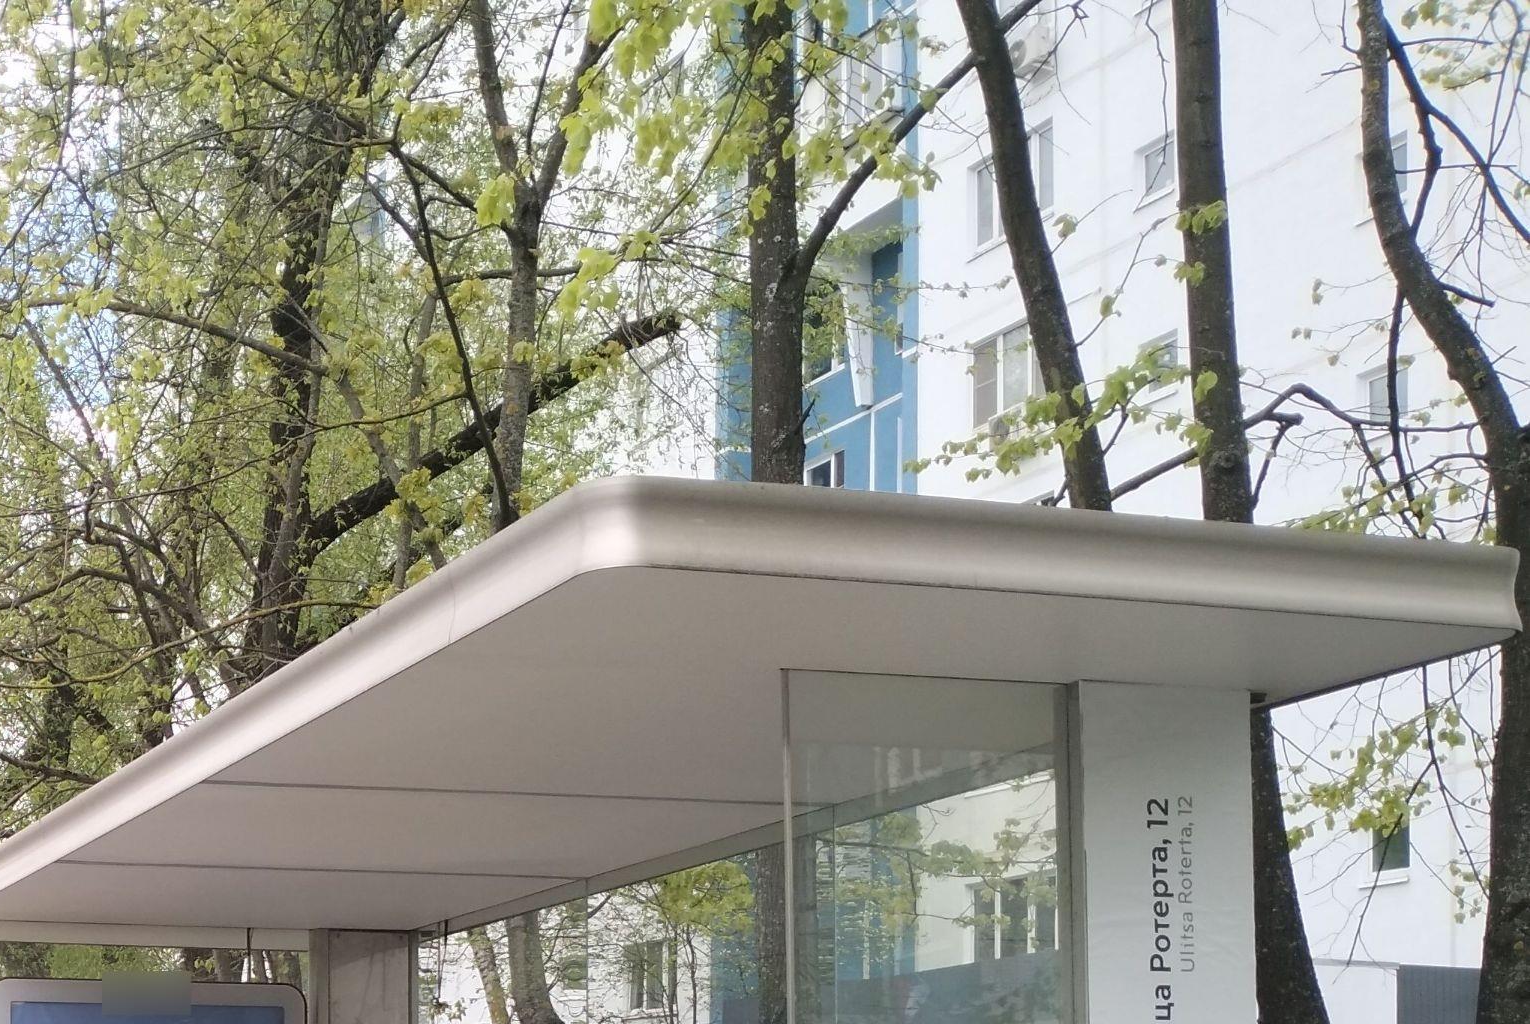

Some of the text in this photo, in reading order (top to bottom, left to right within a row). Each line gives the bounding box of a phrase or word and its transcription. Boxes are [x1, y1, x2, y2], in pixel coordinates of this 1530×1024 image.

[1147, 798, 1169, 829] 12
[1150, 838, 1174, 972] Ротерта,
[1178, 796, 1195, 973] Ulitsa Roterta, 12
